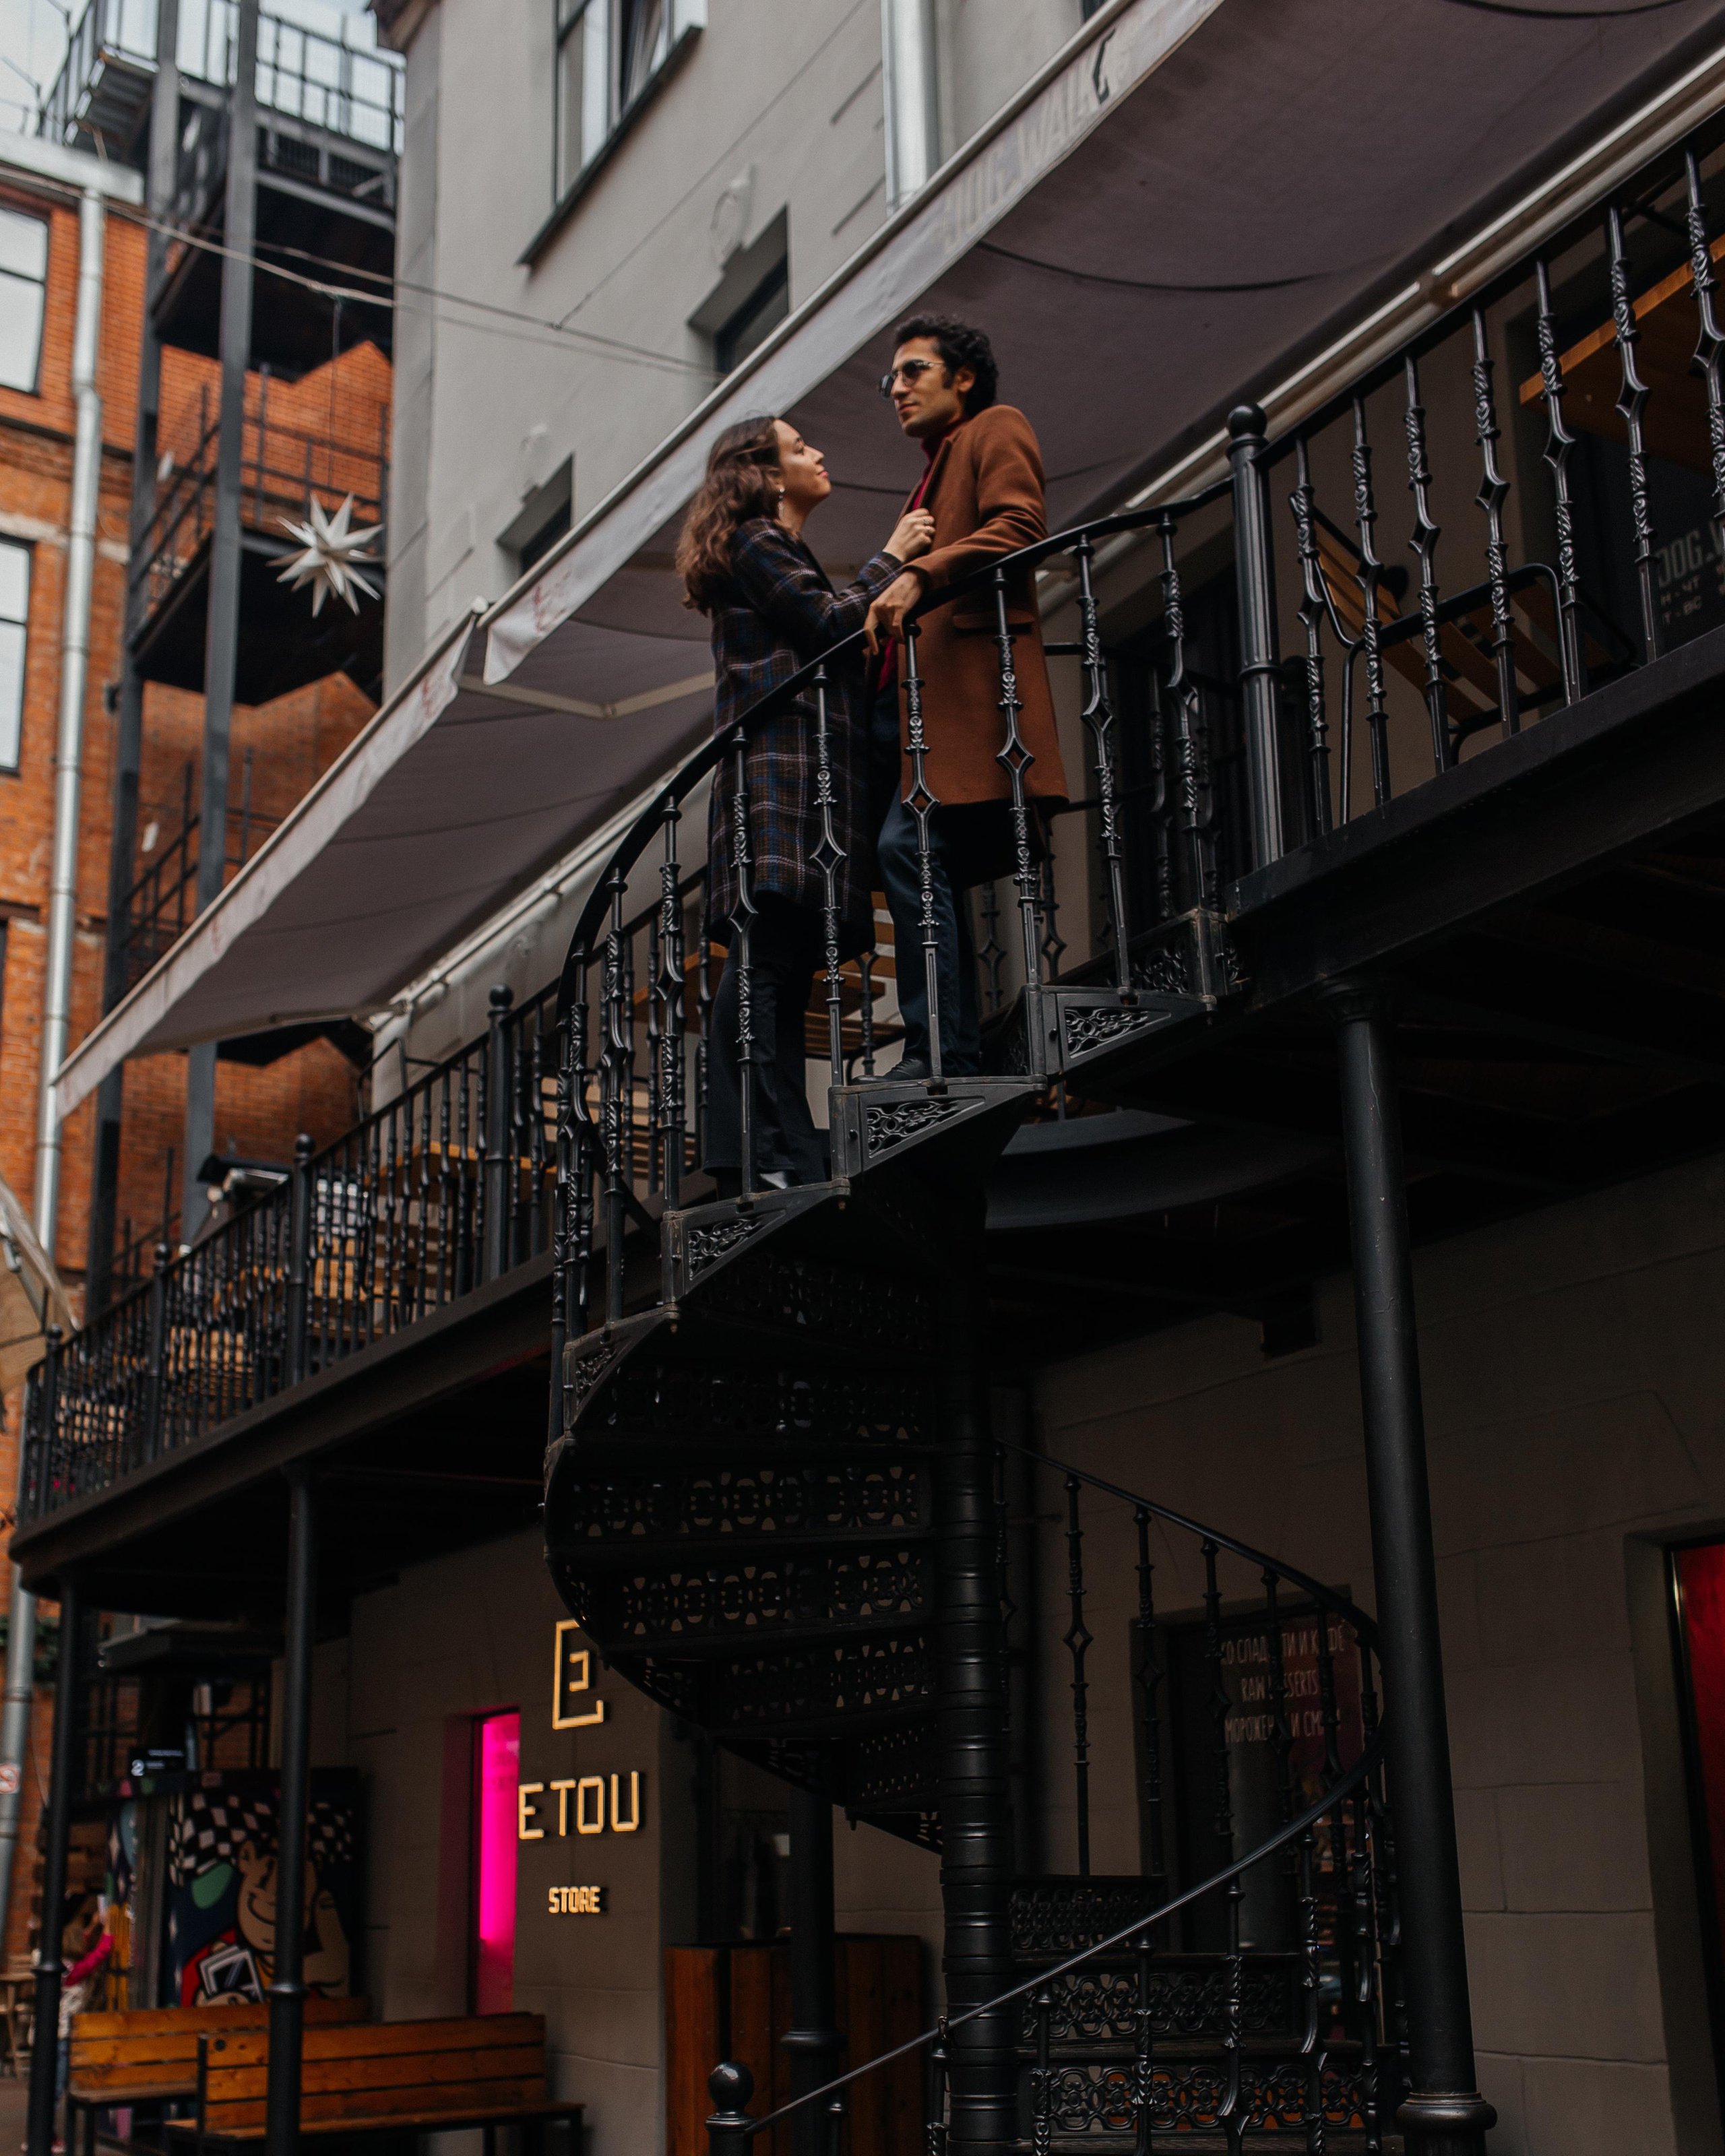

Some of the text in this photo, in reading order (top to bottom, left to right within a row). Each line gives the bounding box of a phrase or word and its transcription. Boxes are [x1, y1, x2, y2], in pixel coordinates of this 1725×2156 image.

[1241, 1675, 1265, 1703] RAW
[518, 1770, 640, 1840] ETOU
[548, 1886, 602, 1914] STORE
